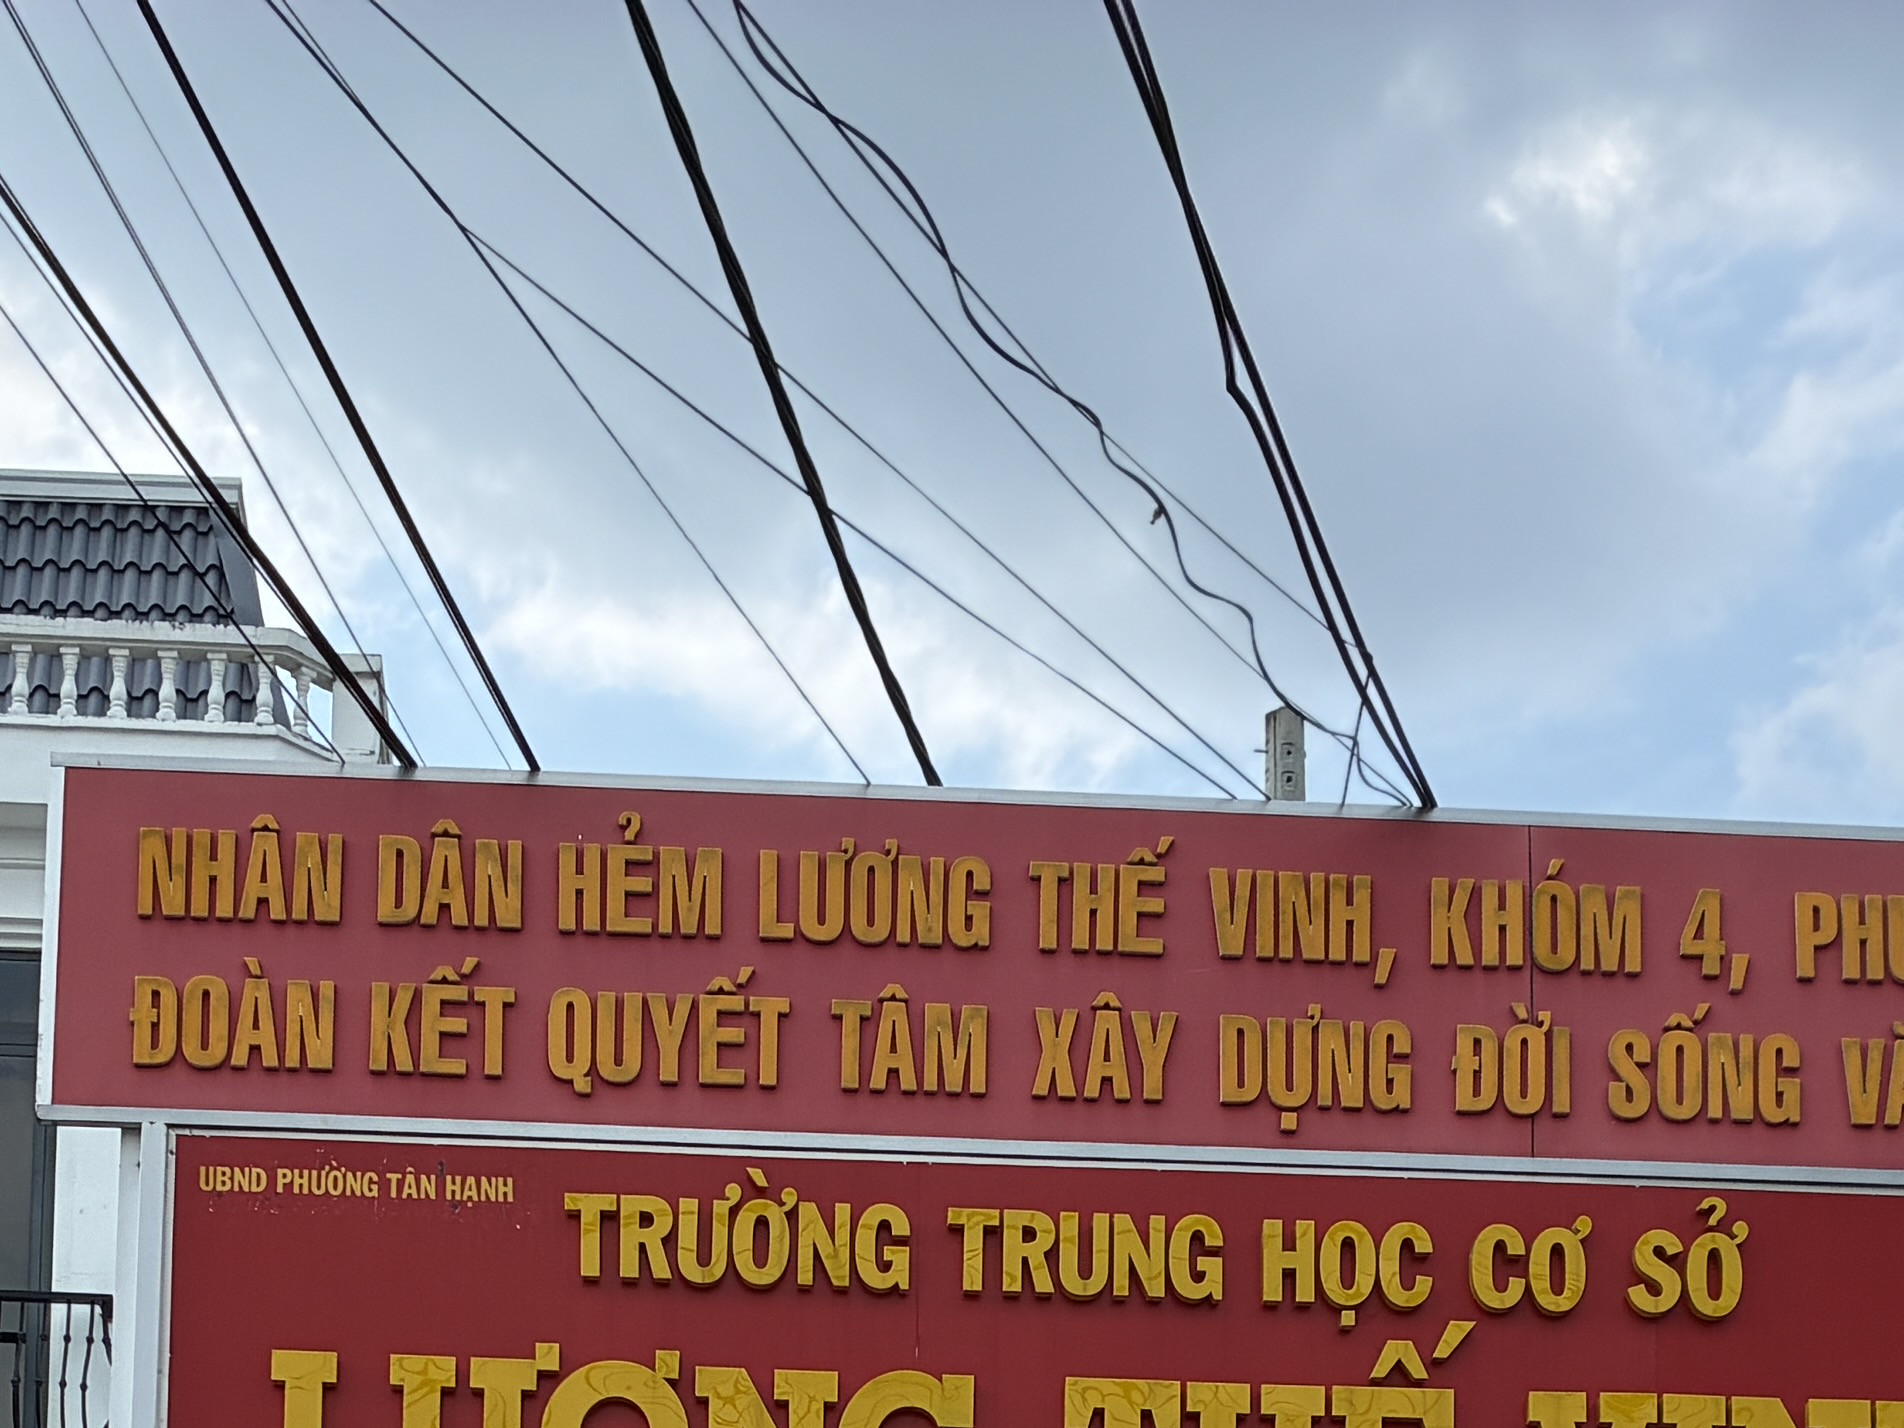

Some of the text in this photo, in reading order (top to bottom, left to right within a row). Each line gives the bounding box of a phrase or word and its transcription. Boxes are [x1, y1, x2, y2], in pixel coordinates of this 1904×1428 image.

[138, 814, 343, 927] NHÂN
[377, 818, 523, 932] DÂN
[558, 811, 722, 939] HẺM
[759, 836, 992, 951] LƯƠNG
[1029, 836, 1176, 958] THẾ
[1209, 867, 1396, 988] VINH,
[1430, 858, 1642, 977] KHÓM
[1680, 888, 1750, 994] 4,
[129, 956, 335, 1073] ĐOÀN
[369, 957, 517, 1079] KẾT
[546, 967, 793, 1097] QUYẾT
[830, 983, 988, 1097] TÂM
[1031, 991, 1178, 1103] XÂY
[1218, 1003, 1412, 1134] DỰNG
[1451, 1002, 1571, 1119] ĐỜI
[1607, 1003, 1802, 1127] SỐNG
[199, 1161, 514, 1207] UBND PHƯỜNG TÂN HẠNH
[564, 1167, 1749, 1331] TRƯỜNG TRUNG HỌC CƠ SỞ
